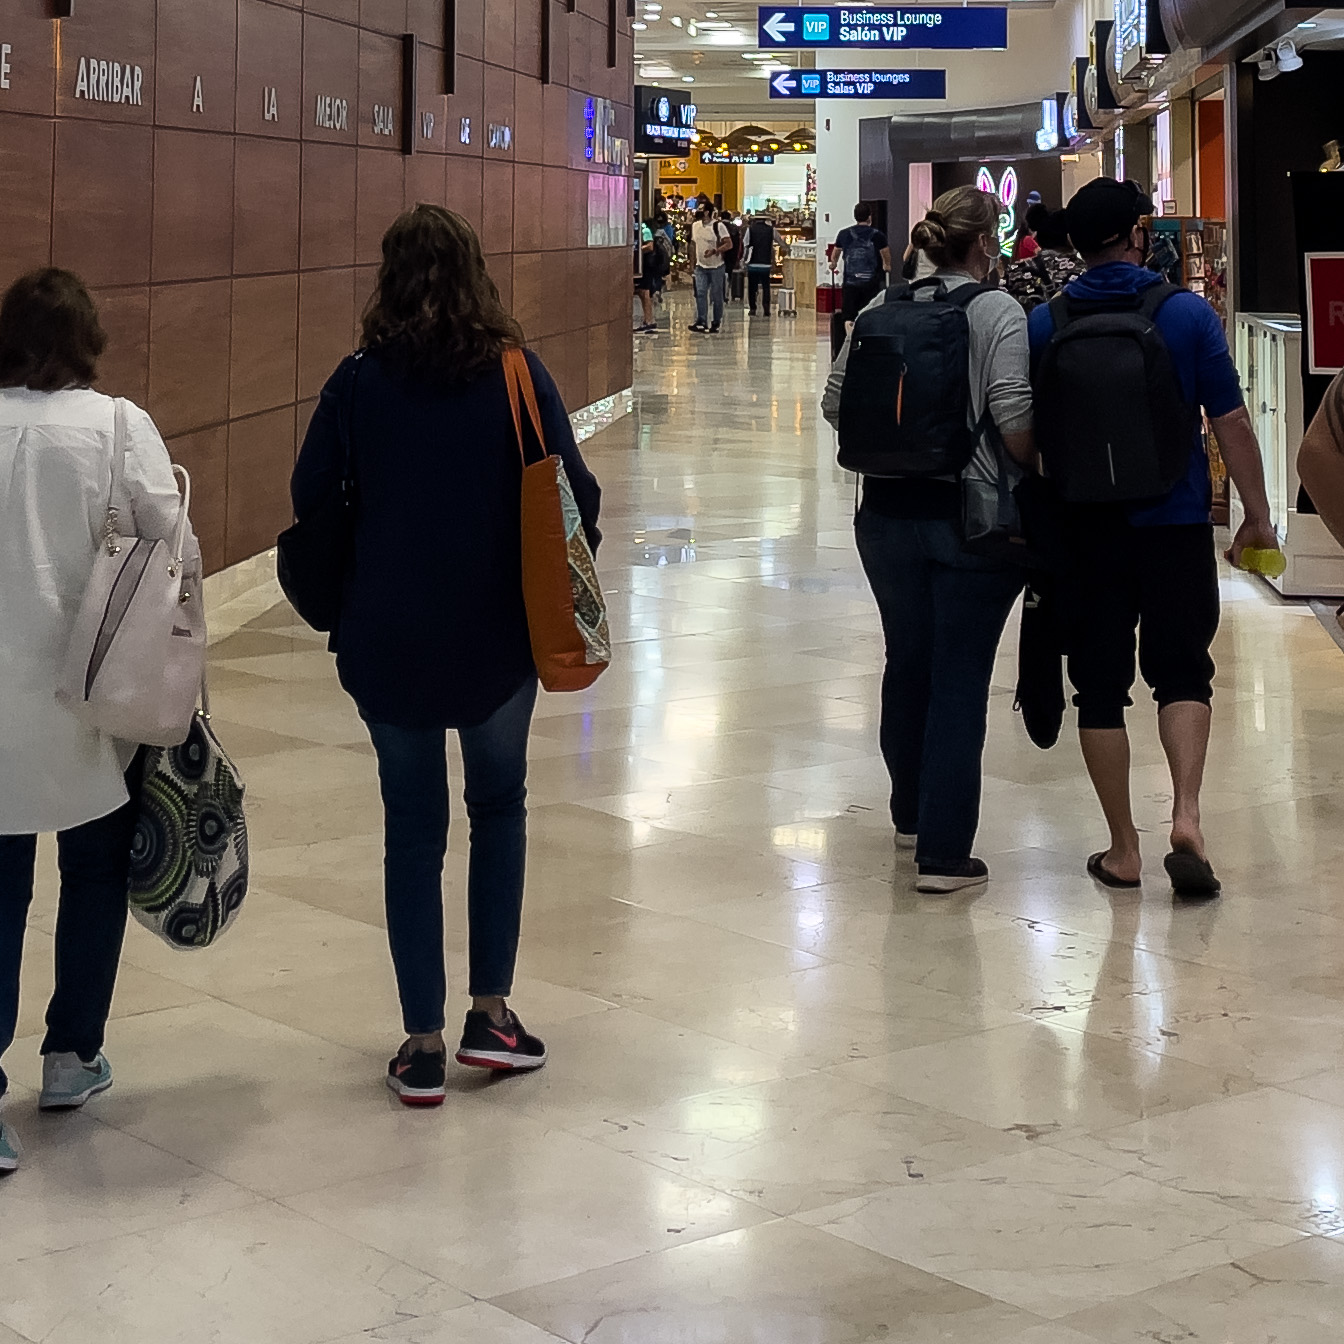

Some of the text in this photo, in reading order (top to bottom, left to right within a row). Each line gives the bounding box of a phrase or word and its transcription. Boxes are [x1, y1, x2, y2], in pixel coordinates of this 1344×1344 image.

[805, 10, 943, 34] VIP Business Lounge
[838, 26, 908, 42] Salón VIP
[802, 71, 910, 89] VIP Business lounges
[826, 82, 875, 95] Salas VIP
[74, 56, 144, 106] ARRIBAR
[191, 74, 204, 113] A
[263, 86, 279, 123] LA
[315, 94, 349, 132] MEJOR
